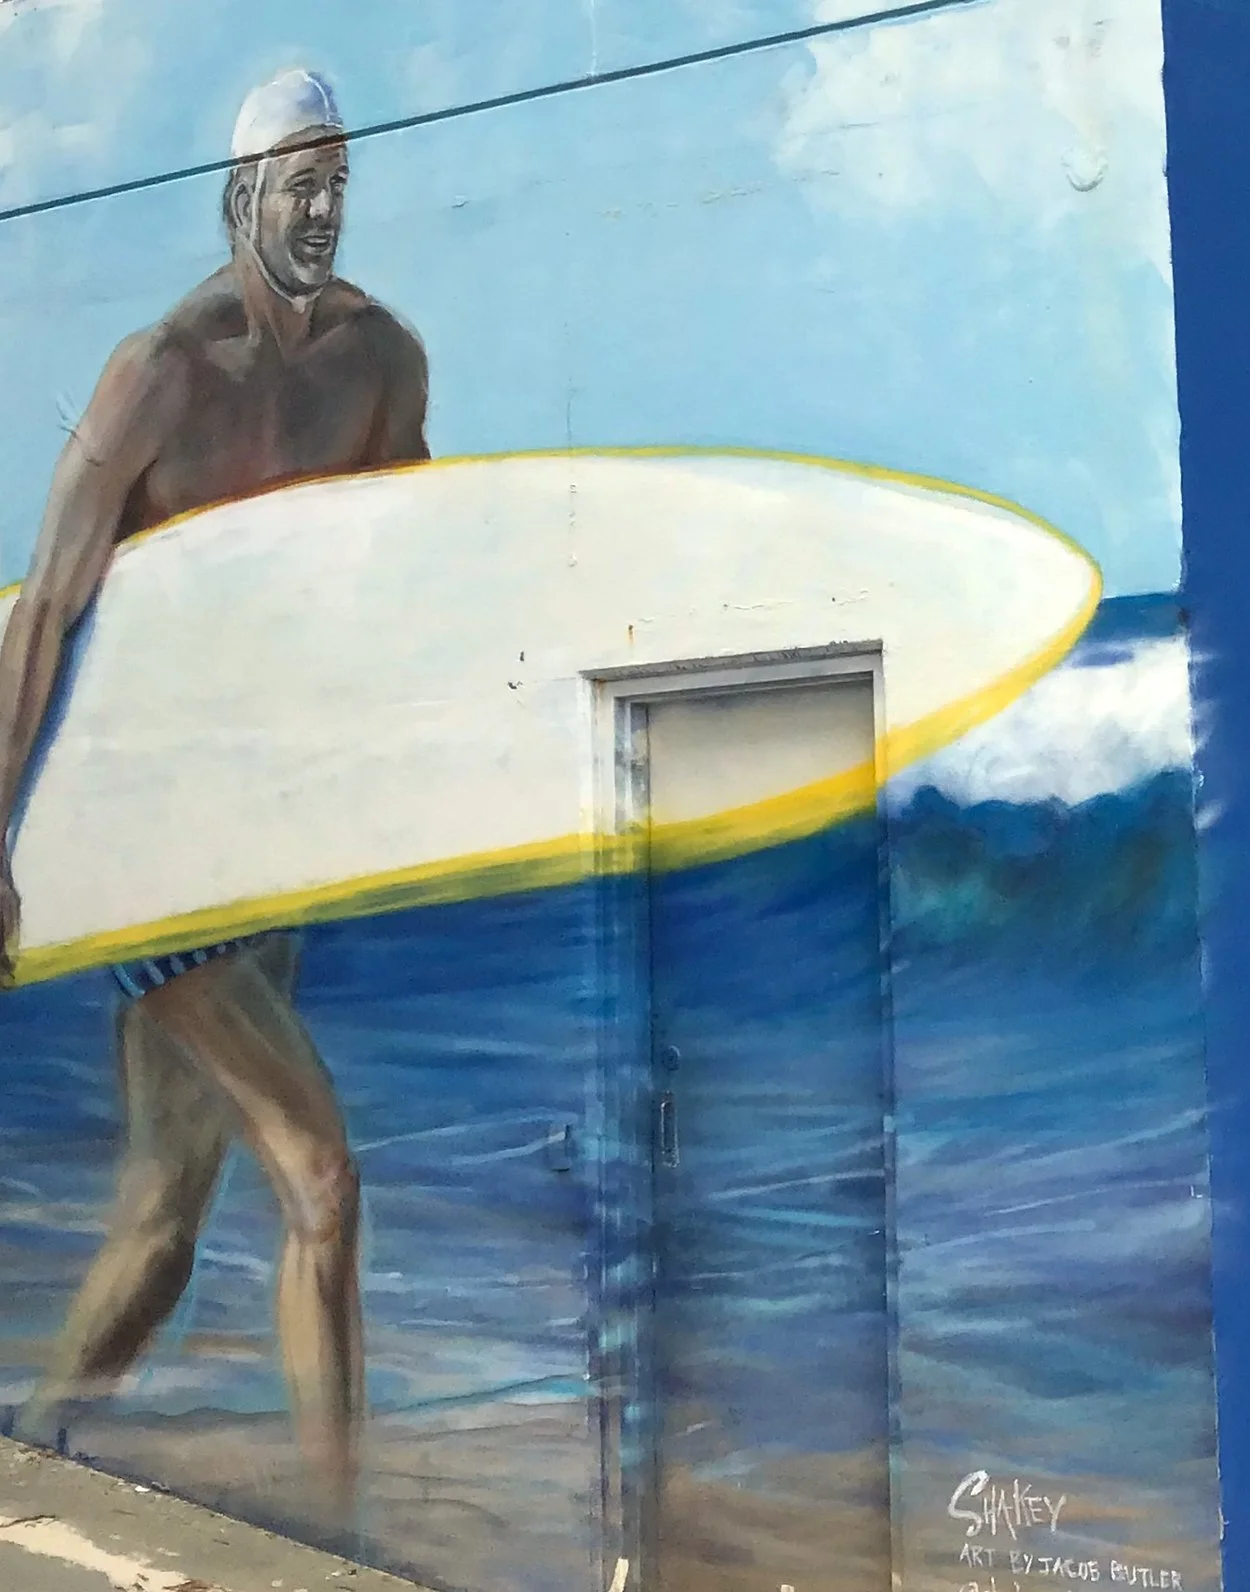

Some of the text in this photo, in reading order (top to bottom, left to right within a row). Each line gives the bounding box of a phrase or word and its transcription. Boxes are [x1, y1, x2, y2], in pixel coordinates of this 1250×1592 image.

[948, 1469, 1067, 1541] SHAKEY
[959, 1543, 1184, 1592] ART BY JACOB BUTLER
